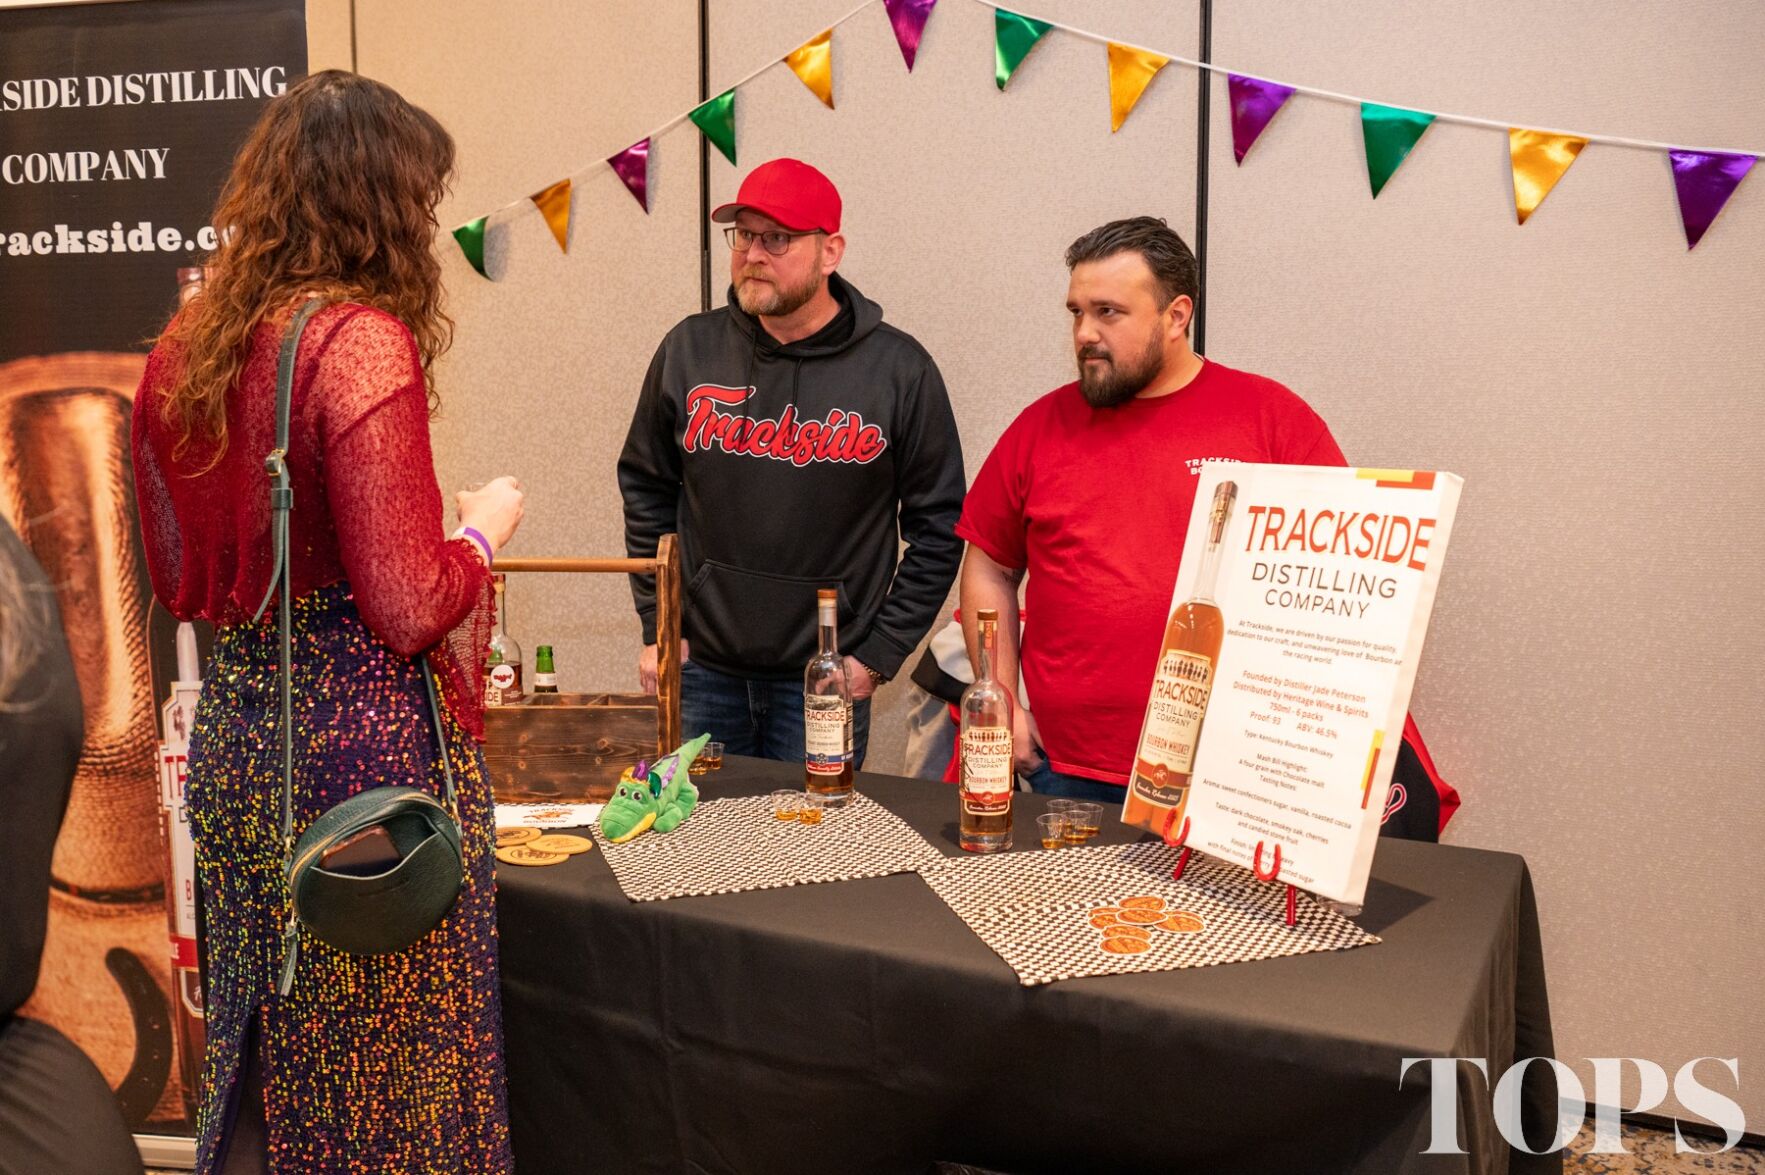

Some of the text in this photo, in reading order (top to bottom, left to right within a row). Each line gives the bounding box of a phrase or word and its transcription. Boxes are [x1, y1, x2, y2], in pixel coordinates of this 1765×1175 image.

[0, 66, 287, 112] SIDE DISTILLING
[2, 148, 170, 185] COMPANY
[683, 383, 887, 467] Trackside
[1245, 506, 1437, 571] TRACKSIDE
[1251, 562, 1397, 599] DISTILLING
[1265, 588, 1370, 619] COMPANY
[1227, 629, 1256, 638] dedication
[1304, 643, 1340, 656] unwavering
[1341, 648, 1355, 657] love
[1366, 652, 1393, 664] Bourbon
[1296, 630, 1316, 638] driven
[1316, 633, 1324, 641] by
[1336, 638, 1360, 647] passion
[1362, 640, 1372, 648] for
[1294, 652, 1313, 662] racing
[1153, 680, 1208, 710] TRACKSIDE
[1232, 680, 1369, 719] Distributed by Heritage Wine & Spirits
[1242, 670, 1366, 704] Founded by Distiller Jade Peterson
[1153, 701, 1199, 721] DISTILLING
[1156, 712, 1191, 728] COMPANY
[1270, 702, 1292, 714] 750ml
[1296, 708, 1300, 716] 6
[1301, 710, 1324, 722] packs
[1273, 716, 1282, 726] 93
[1259, 734, 1284, 746] Kentucky
[1284, 740, 1309, 752] Bourbon
[1310, 746, 1334, 759] Whiskey
[1315, 727, 1338, 740] 46.5%
[1257, 753, 1272, 763] Mash
[1272, 757, 1281, 765] Bill
[1244, 760, 1255, 768] four
[1256, 763, 1270, 774] grain
[1270, 767, 1282, 776] with
[1283, 771, 1310, 785] Chocolate
[1311, 779, 1326, 788] malt
[1260, 774, 1280, 788] Tasting
[1222, 784, 1237, 794] sweet
[1238, 788, 1273, 806] confectioners
[1312, 812, 1334, 824] roasted
[1335, 820, 1352, 830] cocoa
[1231, 807, 1243, 817] dark
[1271, 820, 1292, 834] smokey
[1306, 832, 1330, 845] cherries
[1238, 821, 1299, 846] and candied stone fruit
[1208, 841, 1220, 849] with
